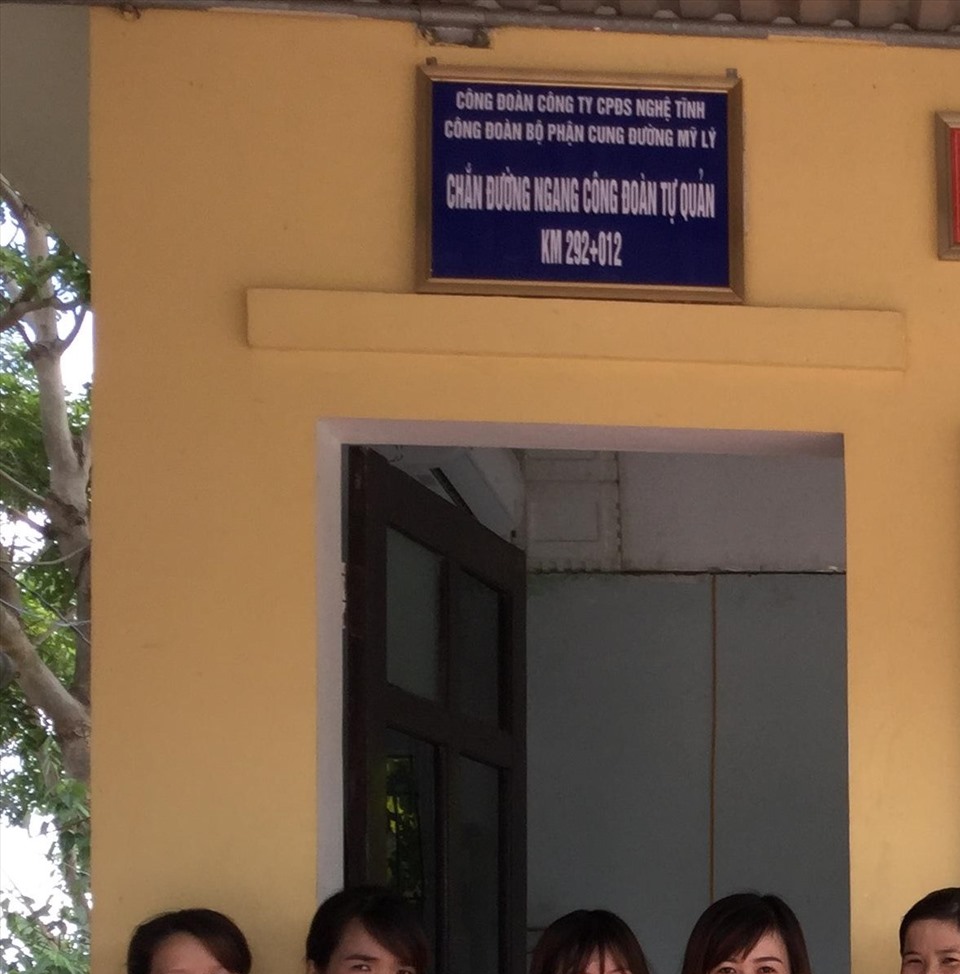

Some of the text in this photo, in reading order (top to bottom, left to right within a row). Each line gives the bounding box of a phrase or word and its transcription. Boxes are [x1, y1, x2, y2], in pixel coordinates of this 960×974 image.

[456, 88, 706, 122] CÔNG ĐOÀN CÔNG TY CPĐS NGHỆ TĨNH
[444, 116, 482, 139] CÔNG
[485, 119, 522, 140] ĐOÀN
[525, 120, 544, 145] BỘ
[548, 121, 585, 146] PHẬN
[588, 125, 624, 144] CUNG
[628, 124, 674, 147] ĐƯỜNG
[678, 126, 697, 148] MỸ
[446, 162, 715, 224] CHẮN ĐƯỜNG NGANG CÔNG ĐOÀN TỰ QUẢN
[541, 229, 622, 267] KM 292+012
